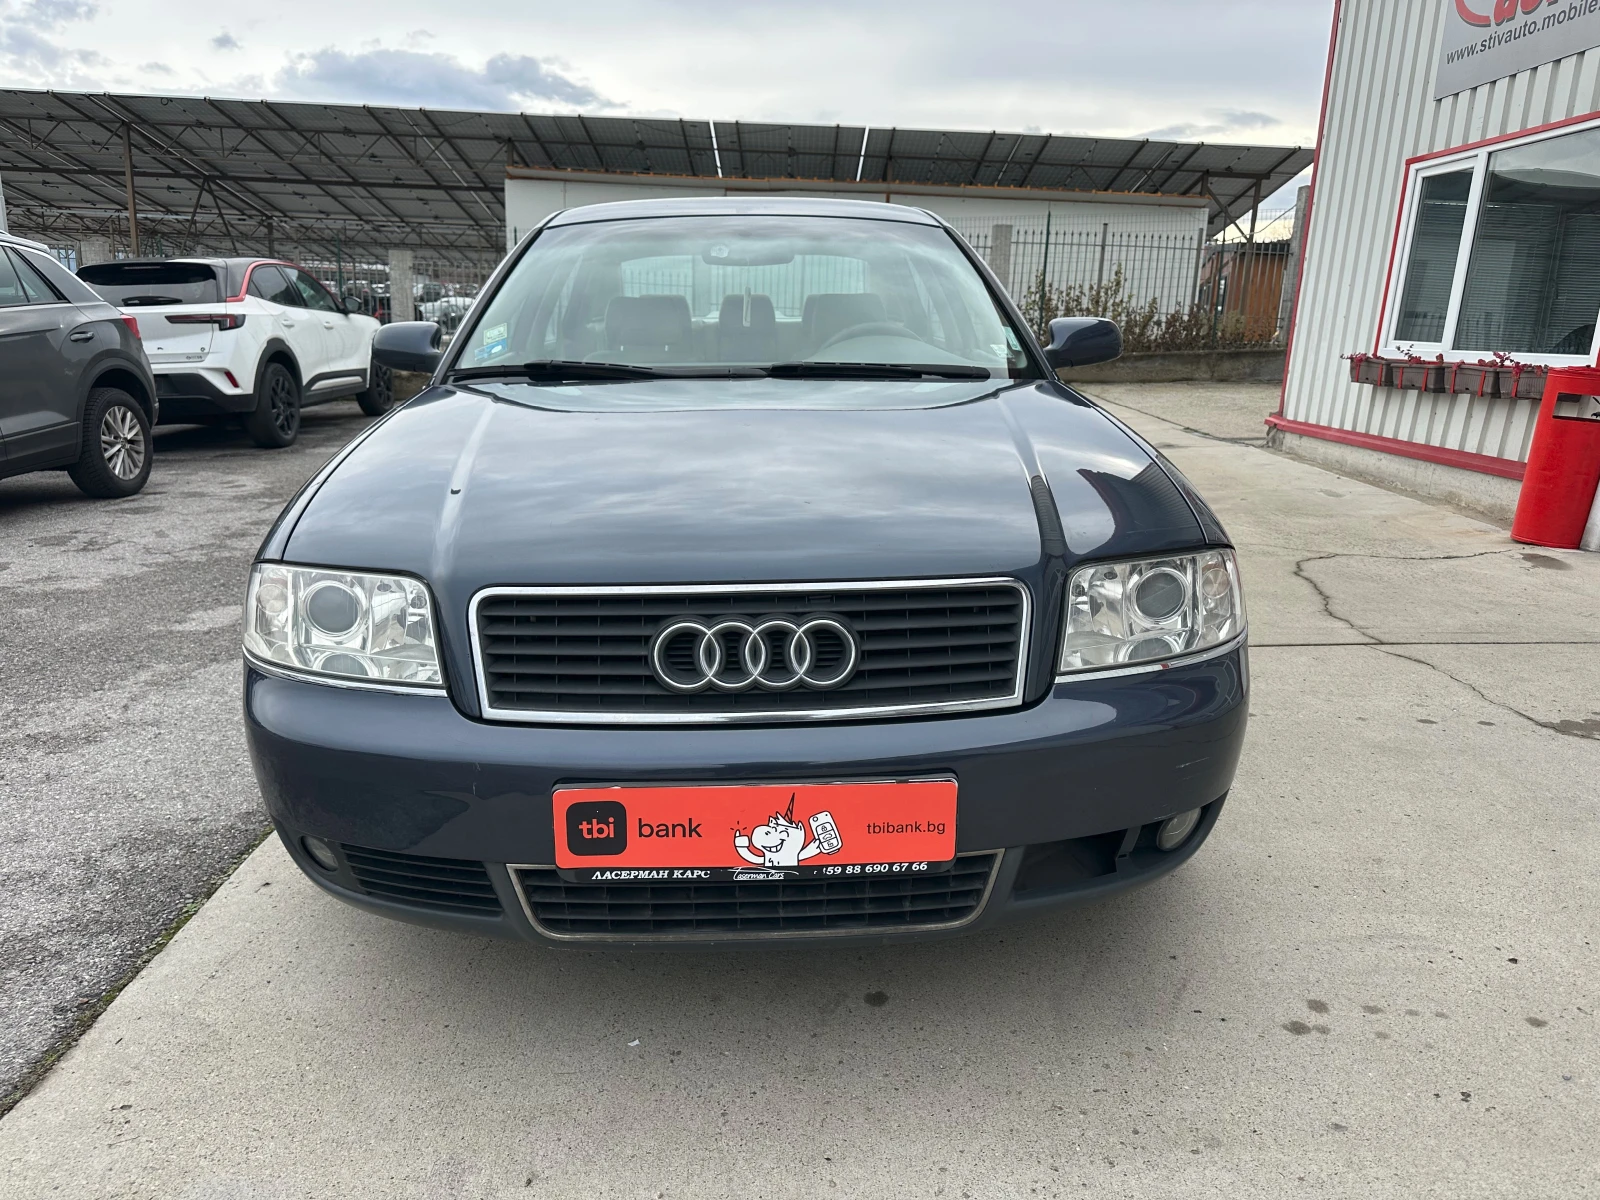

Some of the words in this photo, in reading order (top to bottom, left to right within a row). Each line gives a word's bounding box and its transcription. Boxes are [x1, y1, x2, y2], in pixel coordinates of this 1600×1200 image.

[578, 816, 616, 839] tbi
[638, 818, 703, 838] bank
[866, 820, 946, 835] tbibank.bg
[845, 865, 861, 874] 88
[865, 863, 889, 873] 690
[892, 862, 909, 872] 67
[912, 861, 928, 871] 66
[592, 870, 669, 880] ЛАСЕРМАН
[672, 869, 711, 879] КАРС
[769, 870, 785, 880] Cars
